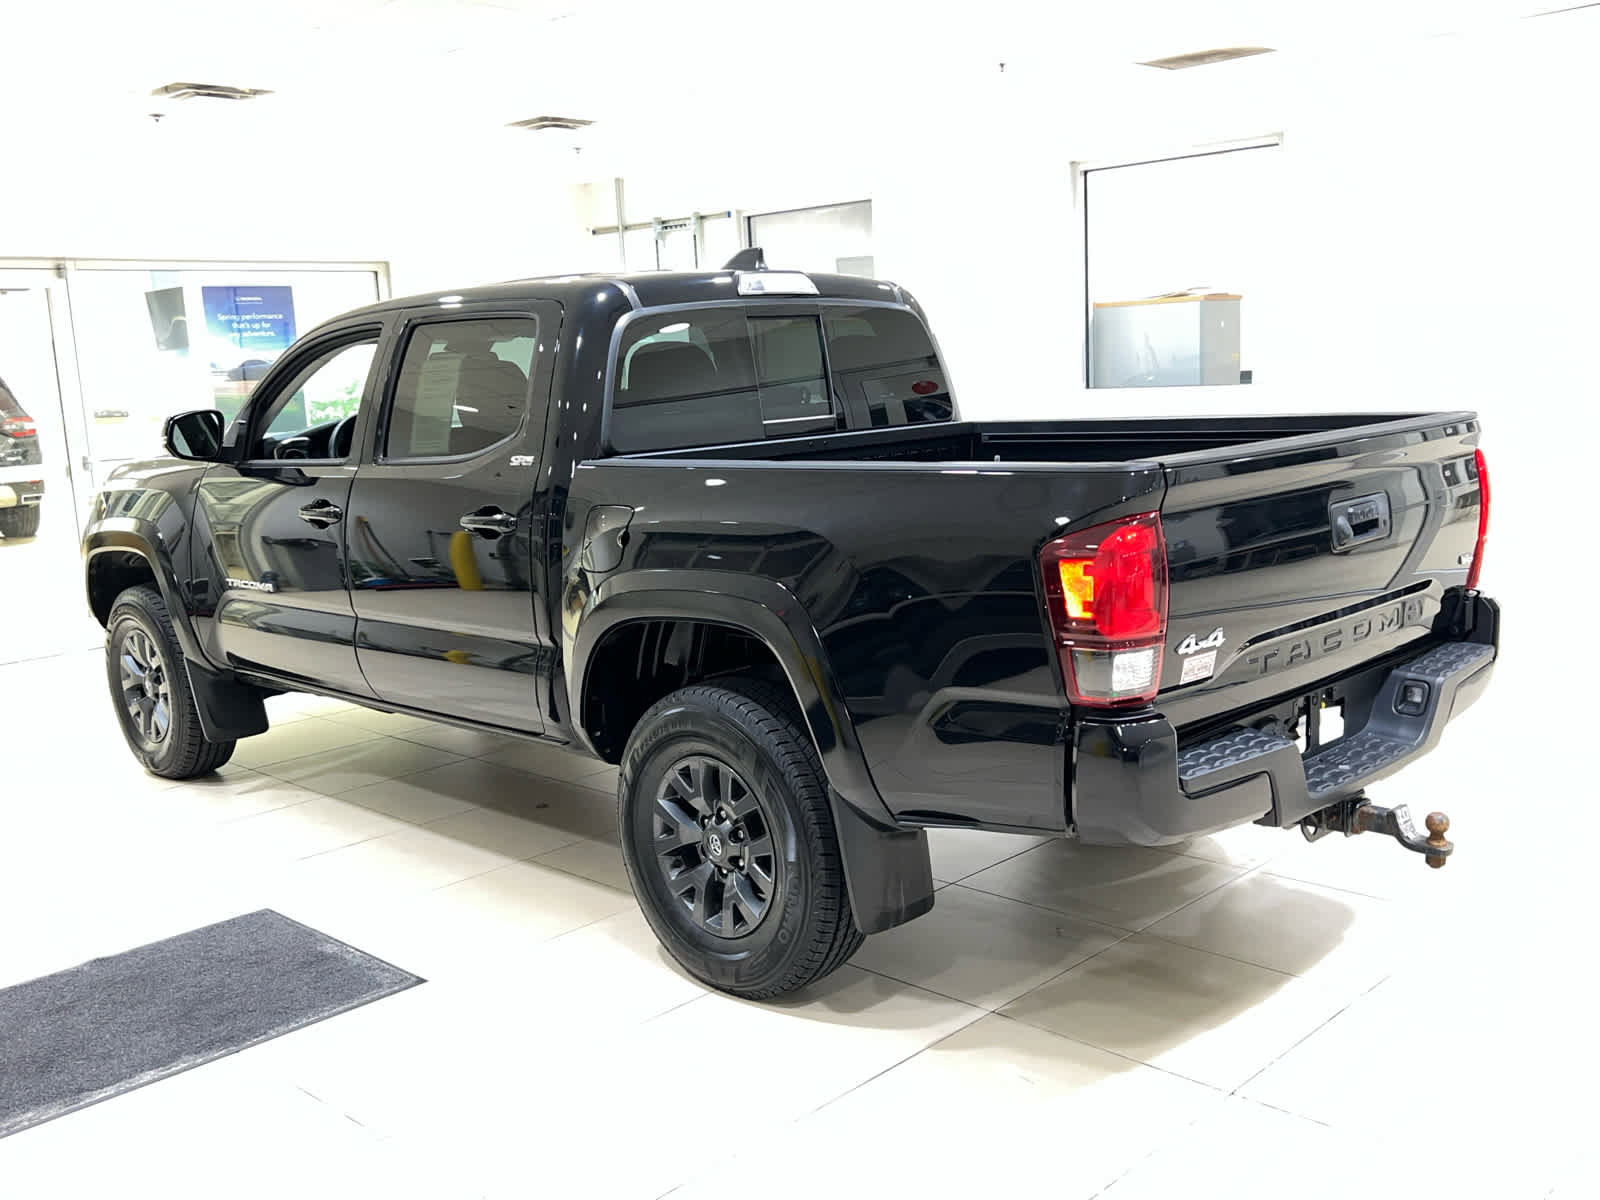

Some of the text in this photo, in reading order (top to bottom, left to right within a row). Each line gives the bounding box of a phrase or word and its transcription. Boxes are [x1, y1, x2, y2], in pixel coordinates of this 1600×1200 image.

[217, 312, 283, 321] Spring performance
[226, 578, 273, 593] TACOMA
[1247, 597, 1424, 675] TACOMA
